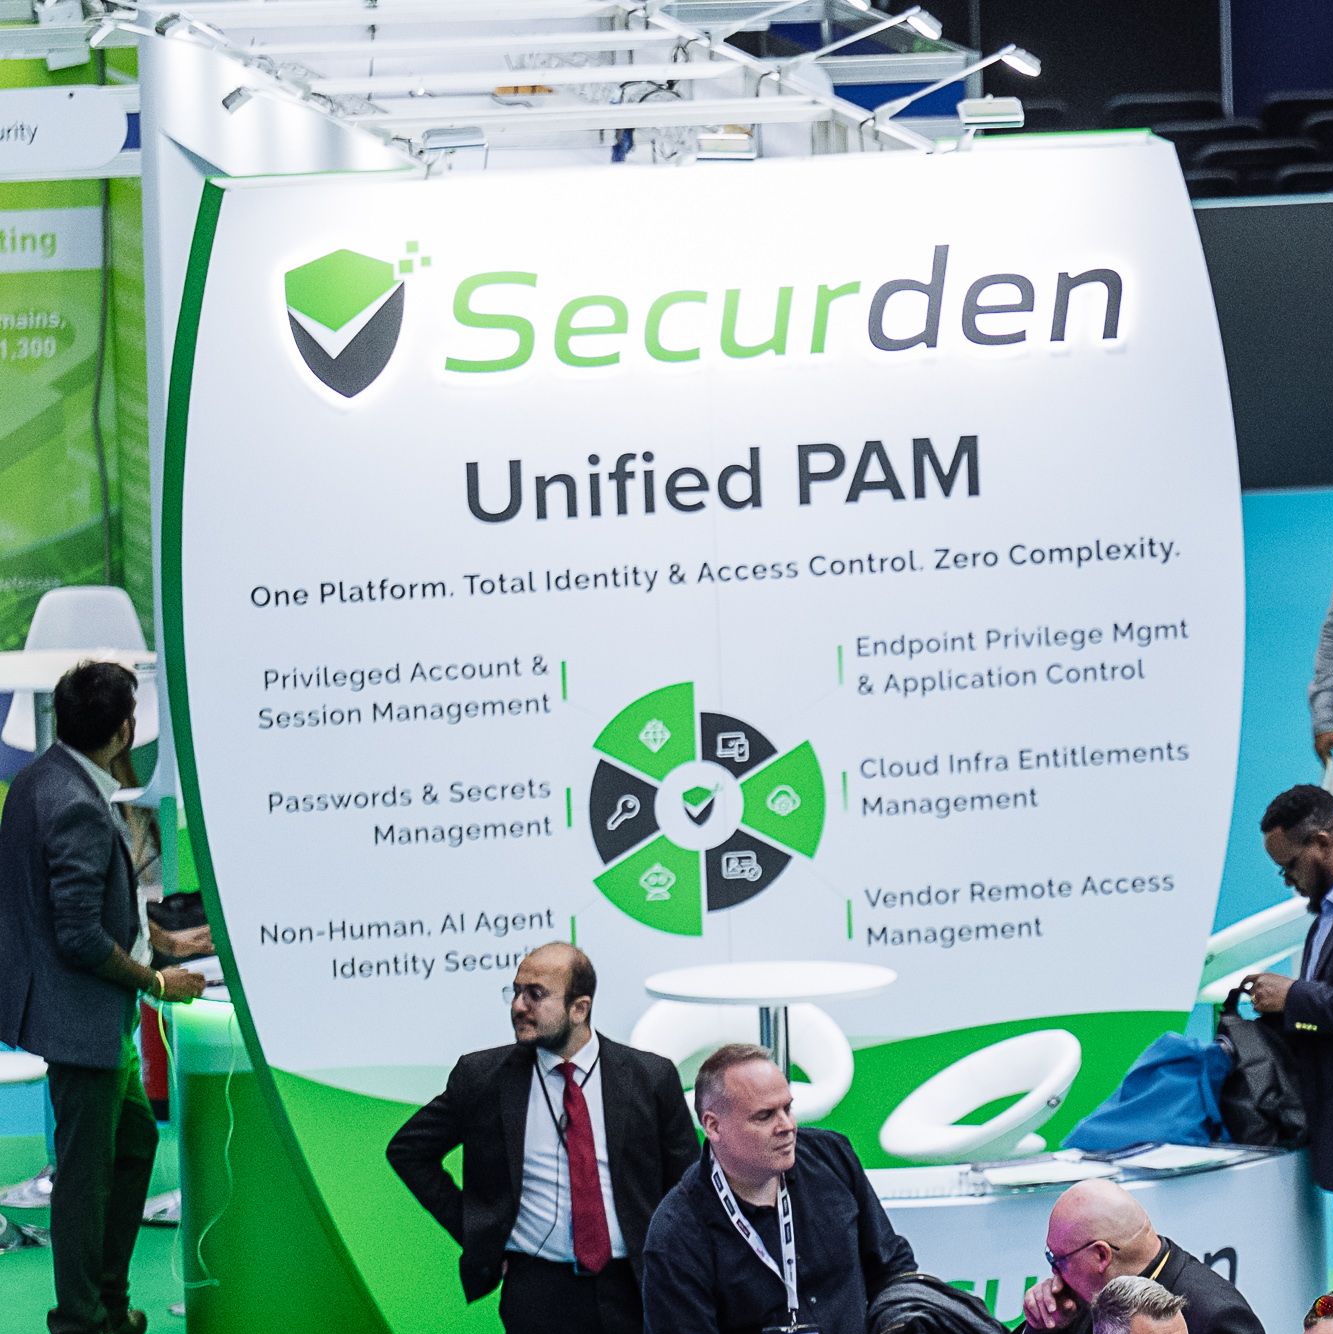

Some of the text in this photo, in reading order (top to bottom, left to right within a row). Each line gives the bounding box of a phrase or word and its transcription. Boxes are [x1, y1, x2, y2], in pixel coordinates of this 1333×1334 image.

[445, 243, 1124, 374] Securden
[465, 434, 981, 523] Unified PAM
[250, 536, 1182, 609] One Platform. Total Identity & Access Control. Zero Complexity.
[856, 619, 1190, 661] Endpoint Privilege Mgmt
[263, 654, 549, 692] Privileged Account &
[857, 659, 1146, 698] & Application Control
[257, 694, 553, 731] Session Management
[860, 742, 1190, 780] Cloud Infra Entitlements
[267, 778, 553, 815] Passwords & Secrets
[861, 786, 1040, 819] Management
[373, 817, 553, 848] Management
[864, 872, 1177, 909] Vendor Remote Access
[440, 912, 467, 935] AI
[474, 908, 558, 939] Agent
[866, 917, 1044, 949] Management
[331, 951, 437, 981] Identity
